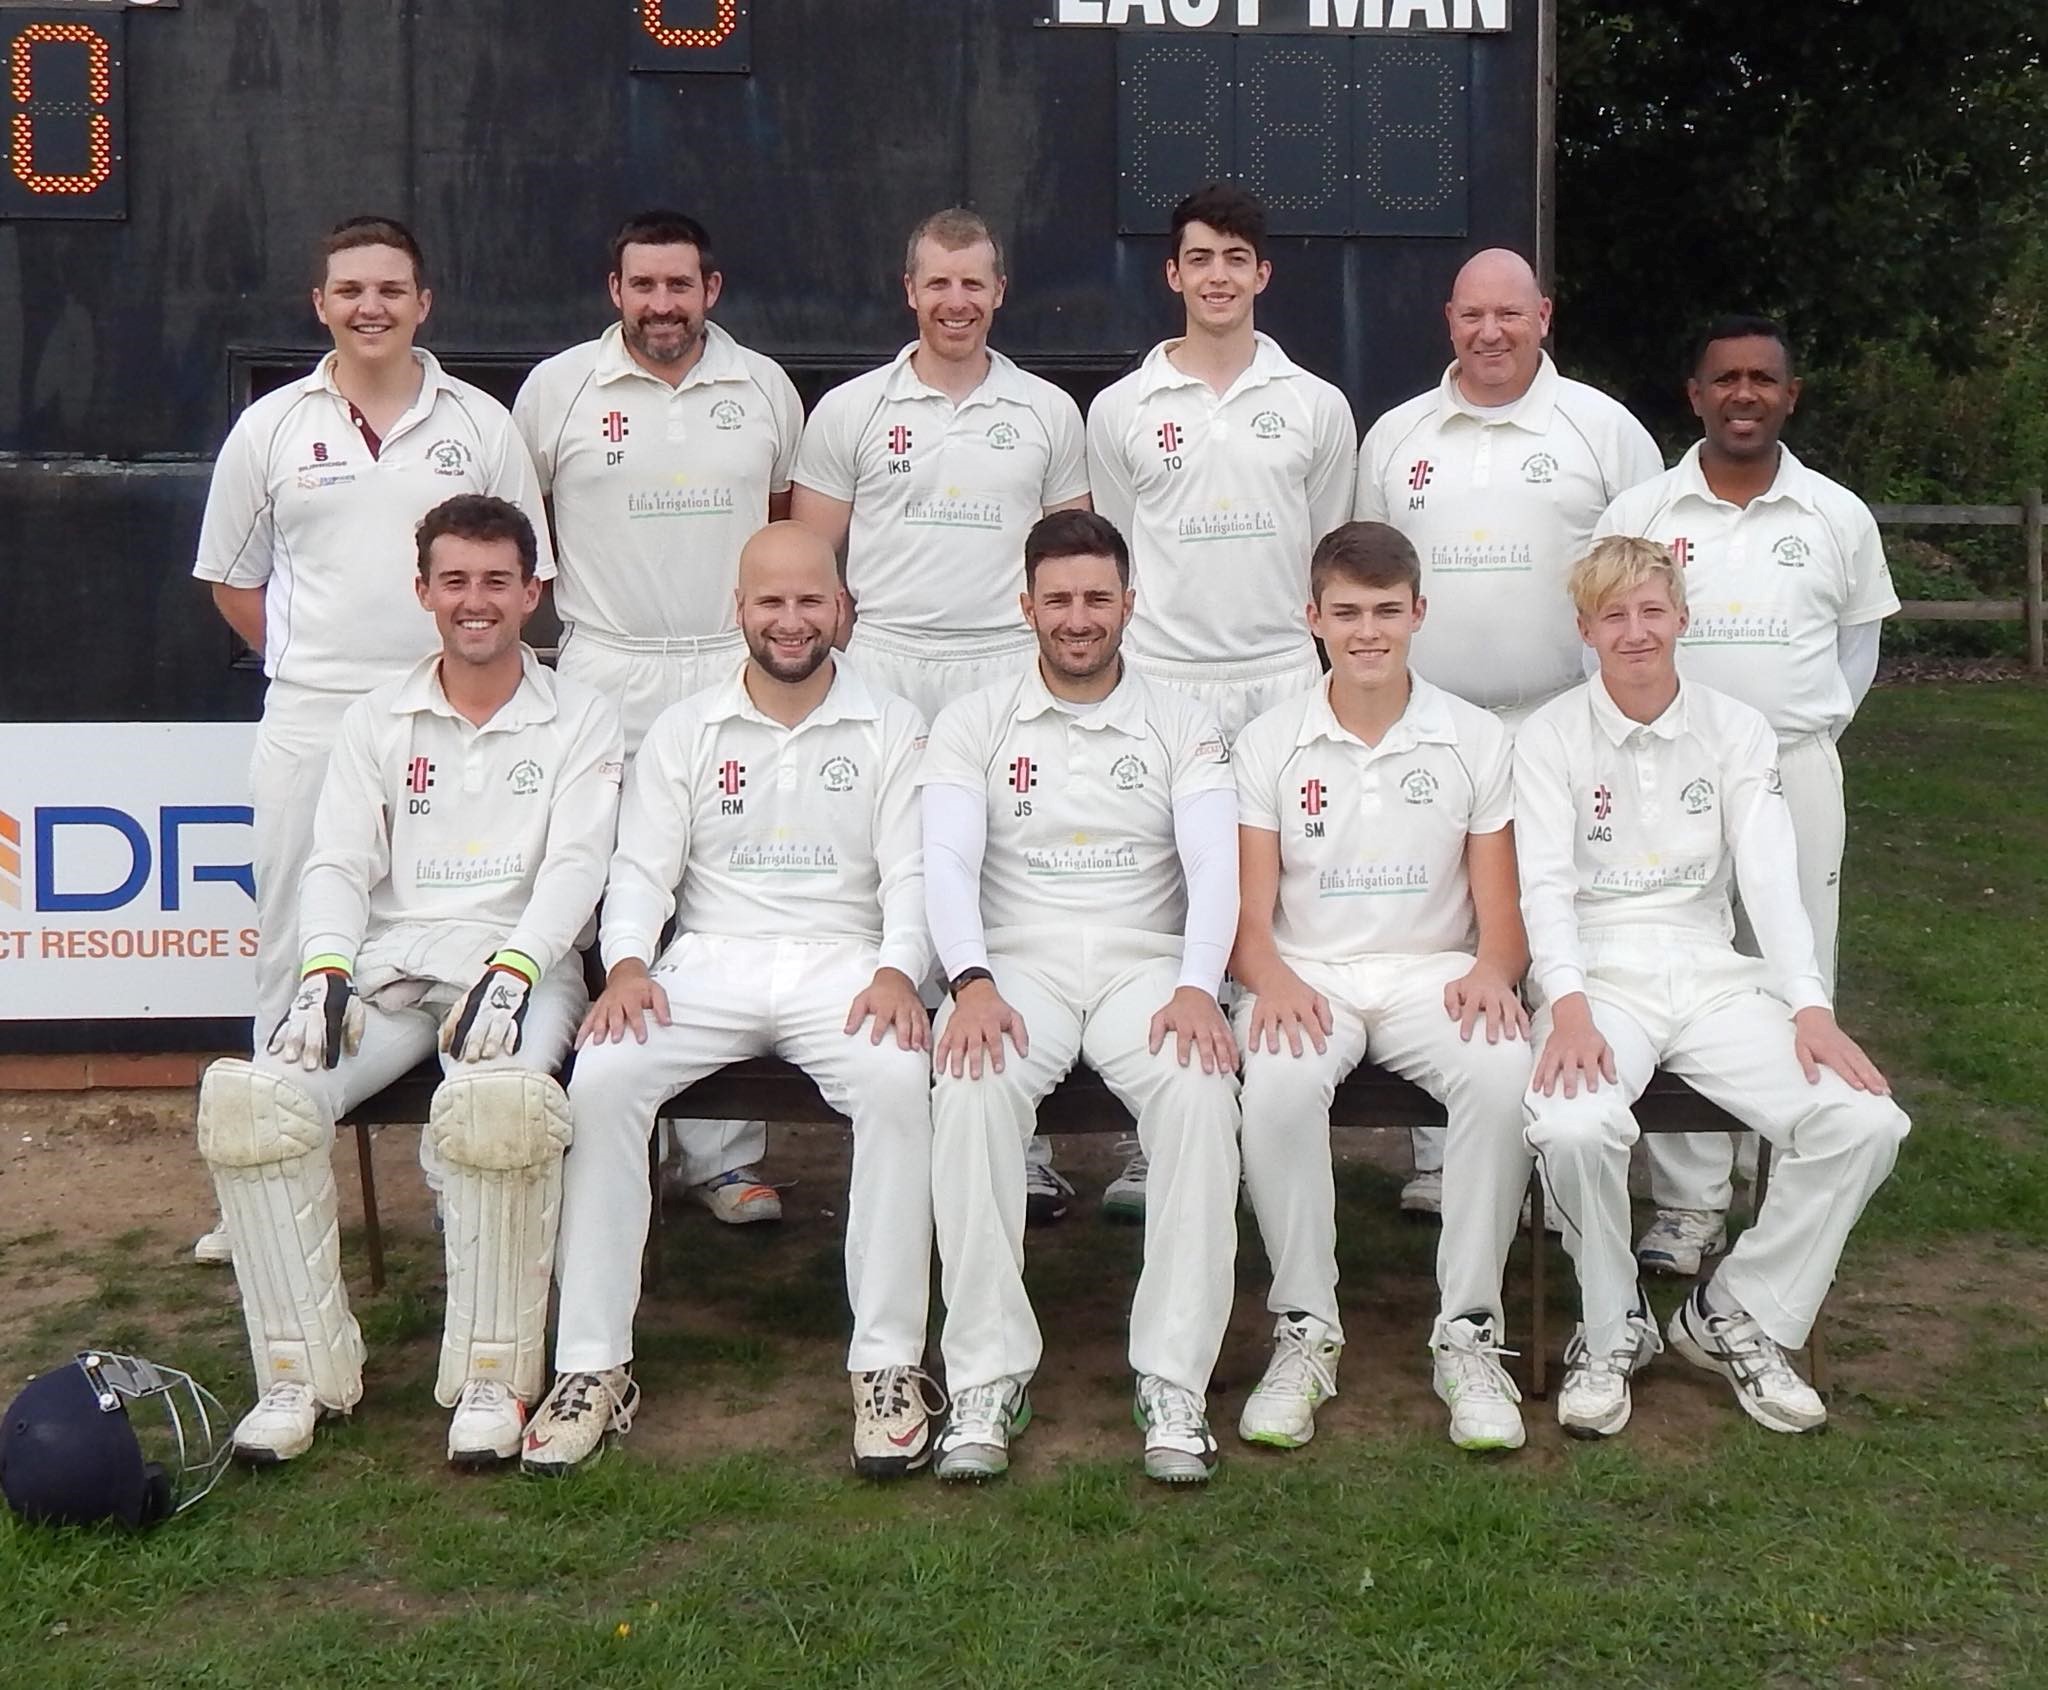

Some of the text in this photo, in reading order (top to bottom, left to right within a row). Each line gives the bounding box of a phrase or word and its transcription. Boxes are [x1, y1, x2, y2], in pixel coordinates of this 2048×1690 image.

[12, 25, 112, 194] 0
[607, 451, 625, 465] DF
[1163, 456, 1182, 471] TO
[888, 460, 911, 475] IKB
[628, 499, 653, 511] Ellis
[656, 497, 710, 511] Irrigation
[1409, 495, 1425, 511] AH
[904, 506, 927, 518] Ellis
[929, 508, 980, 521] Irrigation
[1179, 523, 1202, 536] Ellis
[1205, 521, 1252, 535] Irrigation
[1432, 552, 1452, 565] Ellis
[1455, 552, 1507, 567] Irrigation
[1688, 625, 1704, 638] llis
[1708, 625, 1765, 639] Irrigation
[409, 799, 431, 815] DC
[721, 799, 744, 815] RM
[1014, 800, 1032, 817] JS
[1304, 821, 1325, 838] SM
[1587, 825, 1612, 842] JAG
[730, 853, 755, 865] Ellis
[758, 854, 811, 868] Irrigation
[1054, 857, 1112, 870] Irrigation
[416, 866, 441, 880] Ellis
[444, 866, 501, 882] Irrigation
[1319, 875, 1344, 889] Ellis
[1347, 875, 1403, 890] Irrigation
[42, 929, 229, 960] RESOURCE
